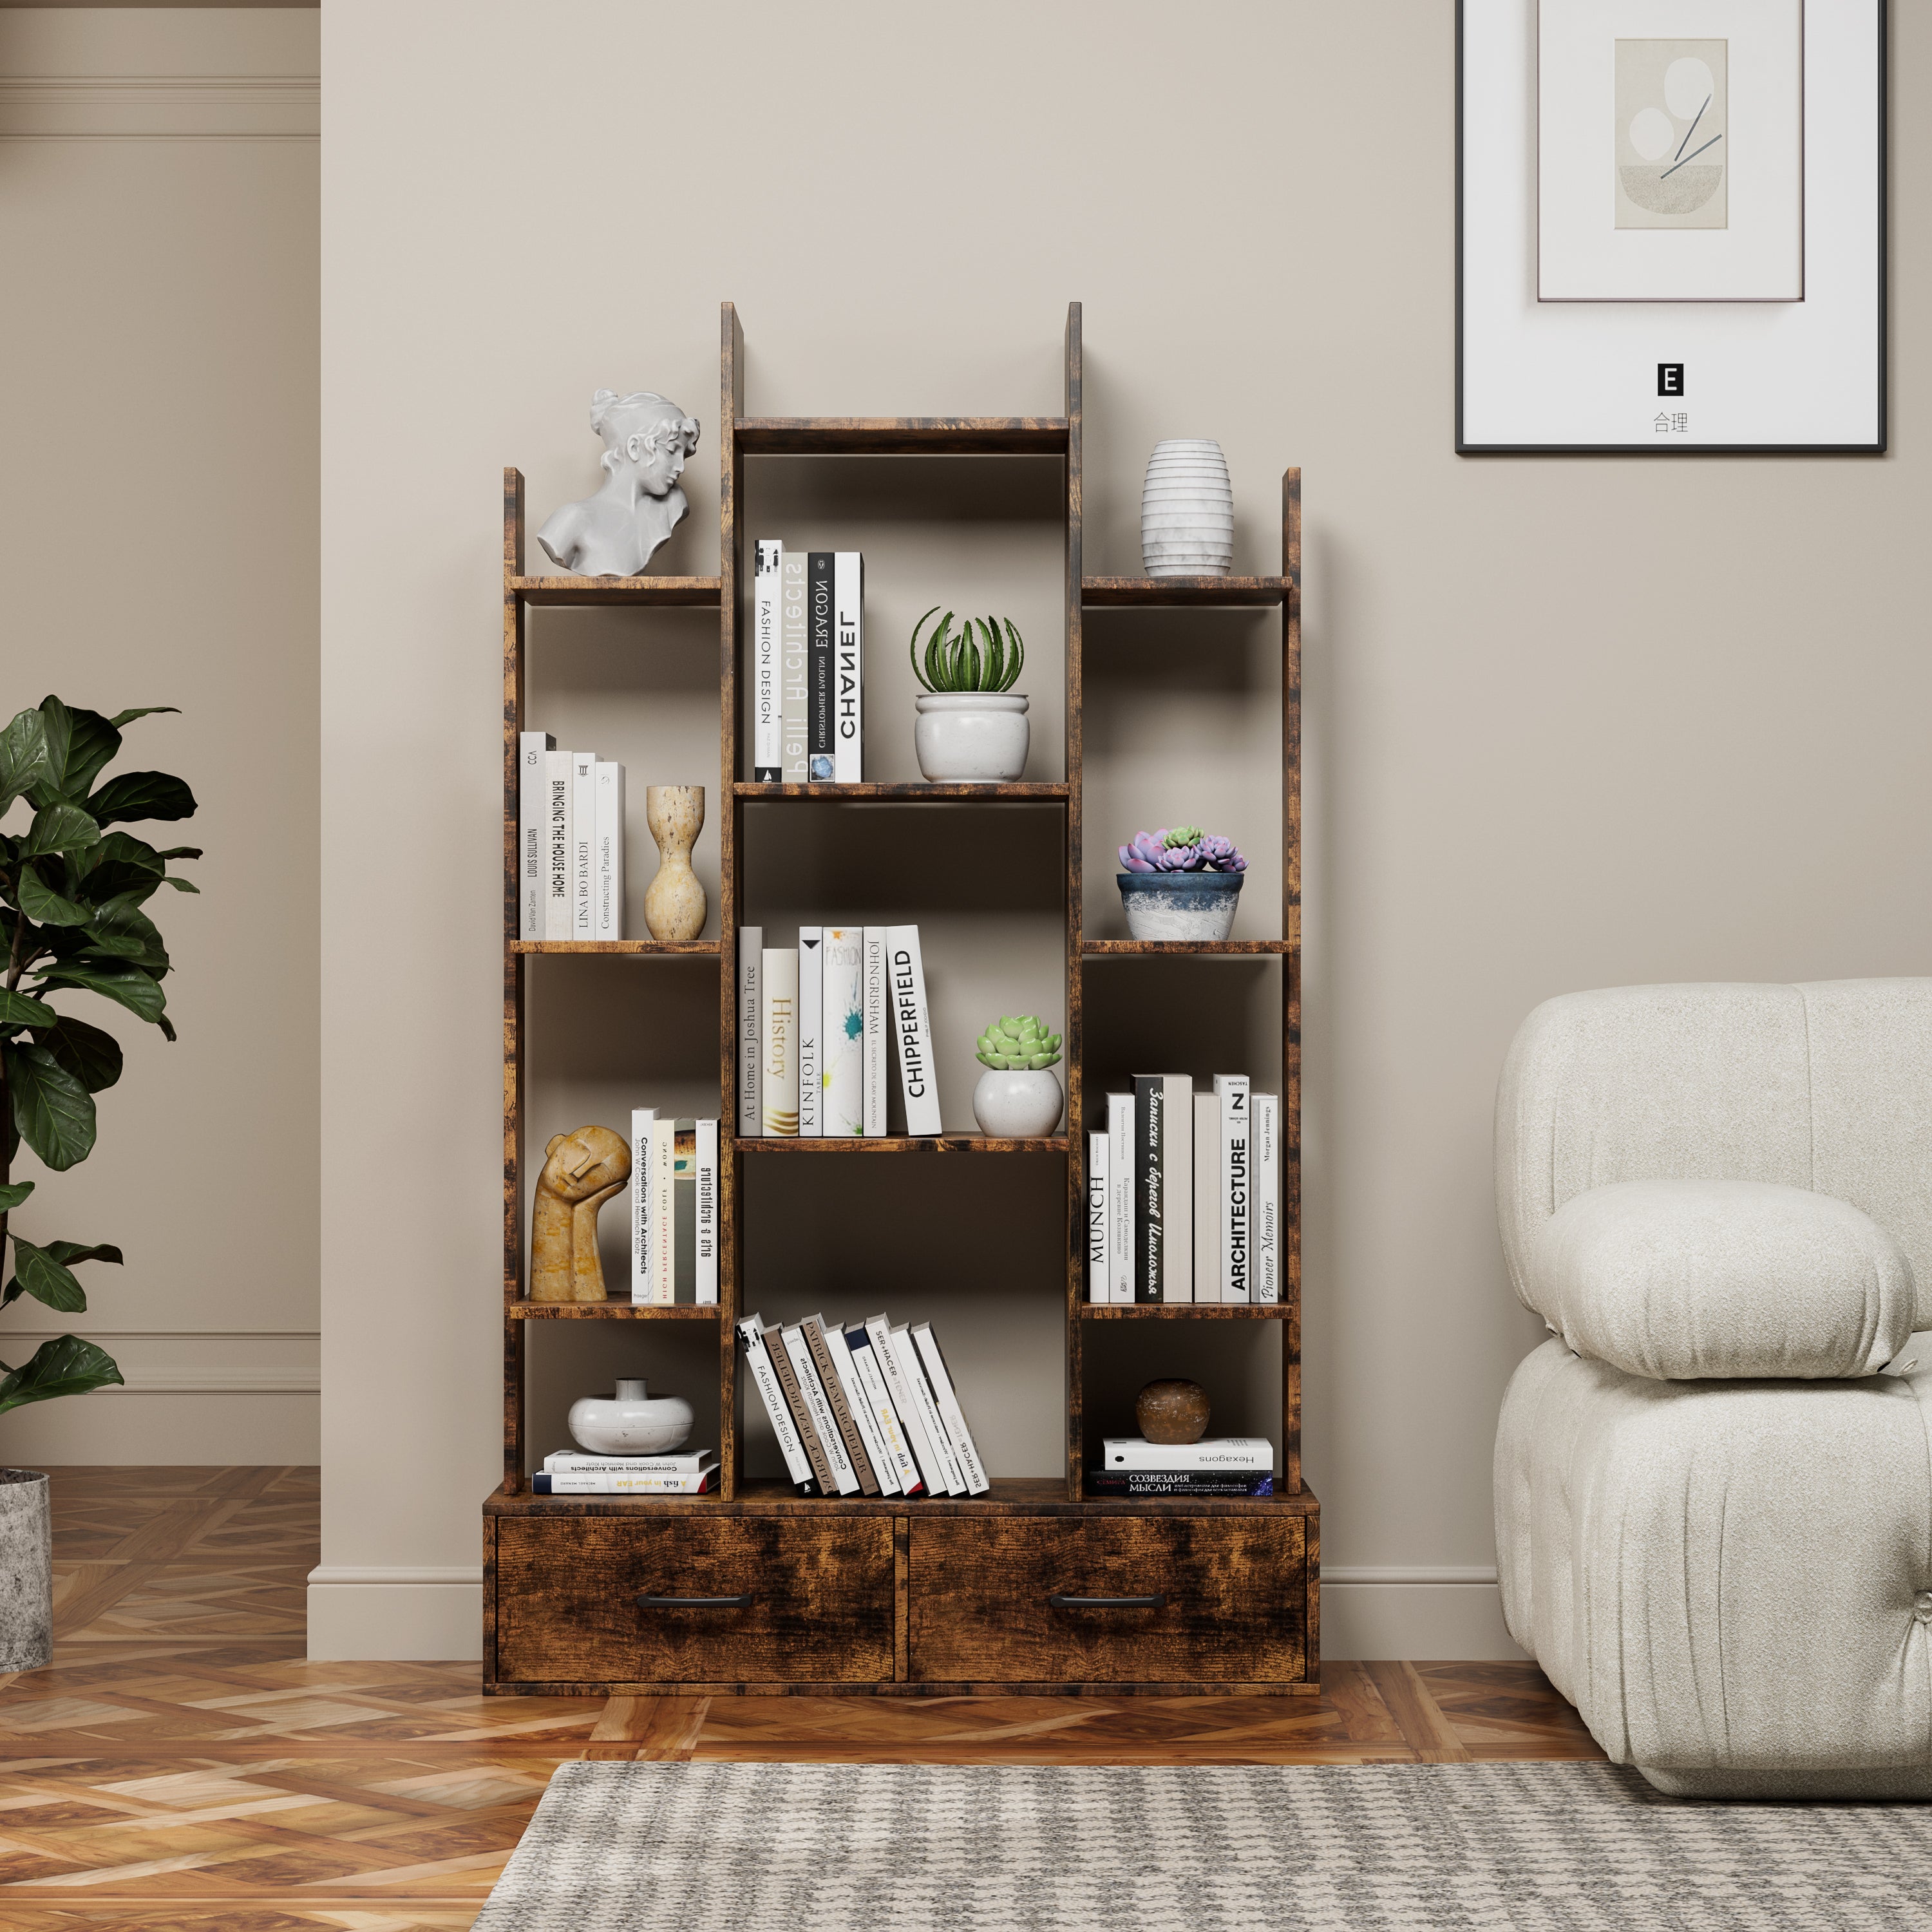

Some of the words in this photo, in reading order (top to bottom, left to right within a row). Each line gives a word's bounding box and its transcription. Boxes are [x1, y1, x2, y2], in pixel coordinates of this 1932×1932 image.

[1664, 368, 1678, 391] E
[1653, 412, 1689, 433] 合理
[761, 601, 771, 664] FASHION
[761, 670, 771, 724] DESIGN
[527, 750, 537, 765] CCA
[552, 781, 565, 822] BRINGING
[527, 829, 538, 858] SULLIVAN
[552, 824, 565, 840] THE
[527, 859, 538, 877] LOUIS
[552, 843, 565, 871] HOUSE
[579, 841, 588, 877] BARDI
[601, 837, 609, 872] Paradies
[528, 890, 536, 907] Zanten
[552, 874, 565, 898] HOME
[579, 880, 589, 896] BO
[528, 907, 536, 917] Van
[579, 900, 588, 928] LINA
[601, 875, 612, 929] Constructing
[528, 917, 536, 932] David
[826, 946, 861, 966] FASHION
[744, 966, 755, 994] Tree
[743, 998, 759, 1044] Joshua
[894, 950, 925, 1098] CHIPPERFIELD
[744, 1046, 755, 1059] in
[767, 998, 792, 1079] History
[744, 1063, 755, 1100] Home
[802, 1037, 814, 1126] KINFOLK
[871, 1072, 876, 1080] DE
[744, 1105, 755, 1121] At
[1148, 1087, 1164, 1148] Записки
[1149, 1153, 1159, 1162] с
[1144, 1166, 1162, 1218] берегов
[1090, 1176, 1104, 1264] MUNCH
[1231, 1139, 1246, 1291] ARCHITECTURE
[1261, 1201, 1274, 1252] Memoirs
[1148, 1222, 1162, 1295] Имоложья
[1261, 1256, 1274, 1299] Pioneer
[757, 1365, 780, 1412] FASHION
[775, 1414, 795, 1453] DESIGN
[806, 1321, 830, 1374] PATRICK
[826, 1376, 867, 1474] DEMARCHELIER
[1198, 1455, 1254, 1463] Hexagons
[1129, 1474, 1189, 1483] СОЗВЕЗДИЯ
[1129, 1484, 1171, 1492] МЫСЛИ
